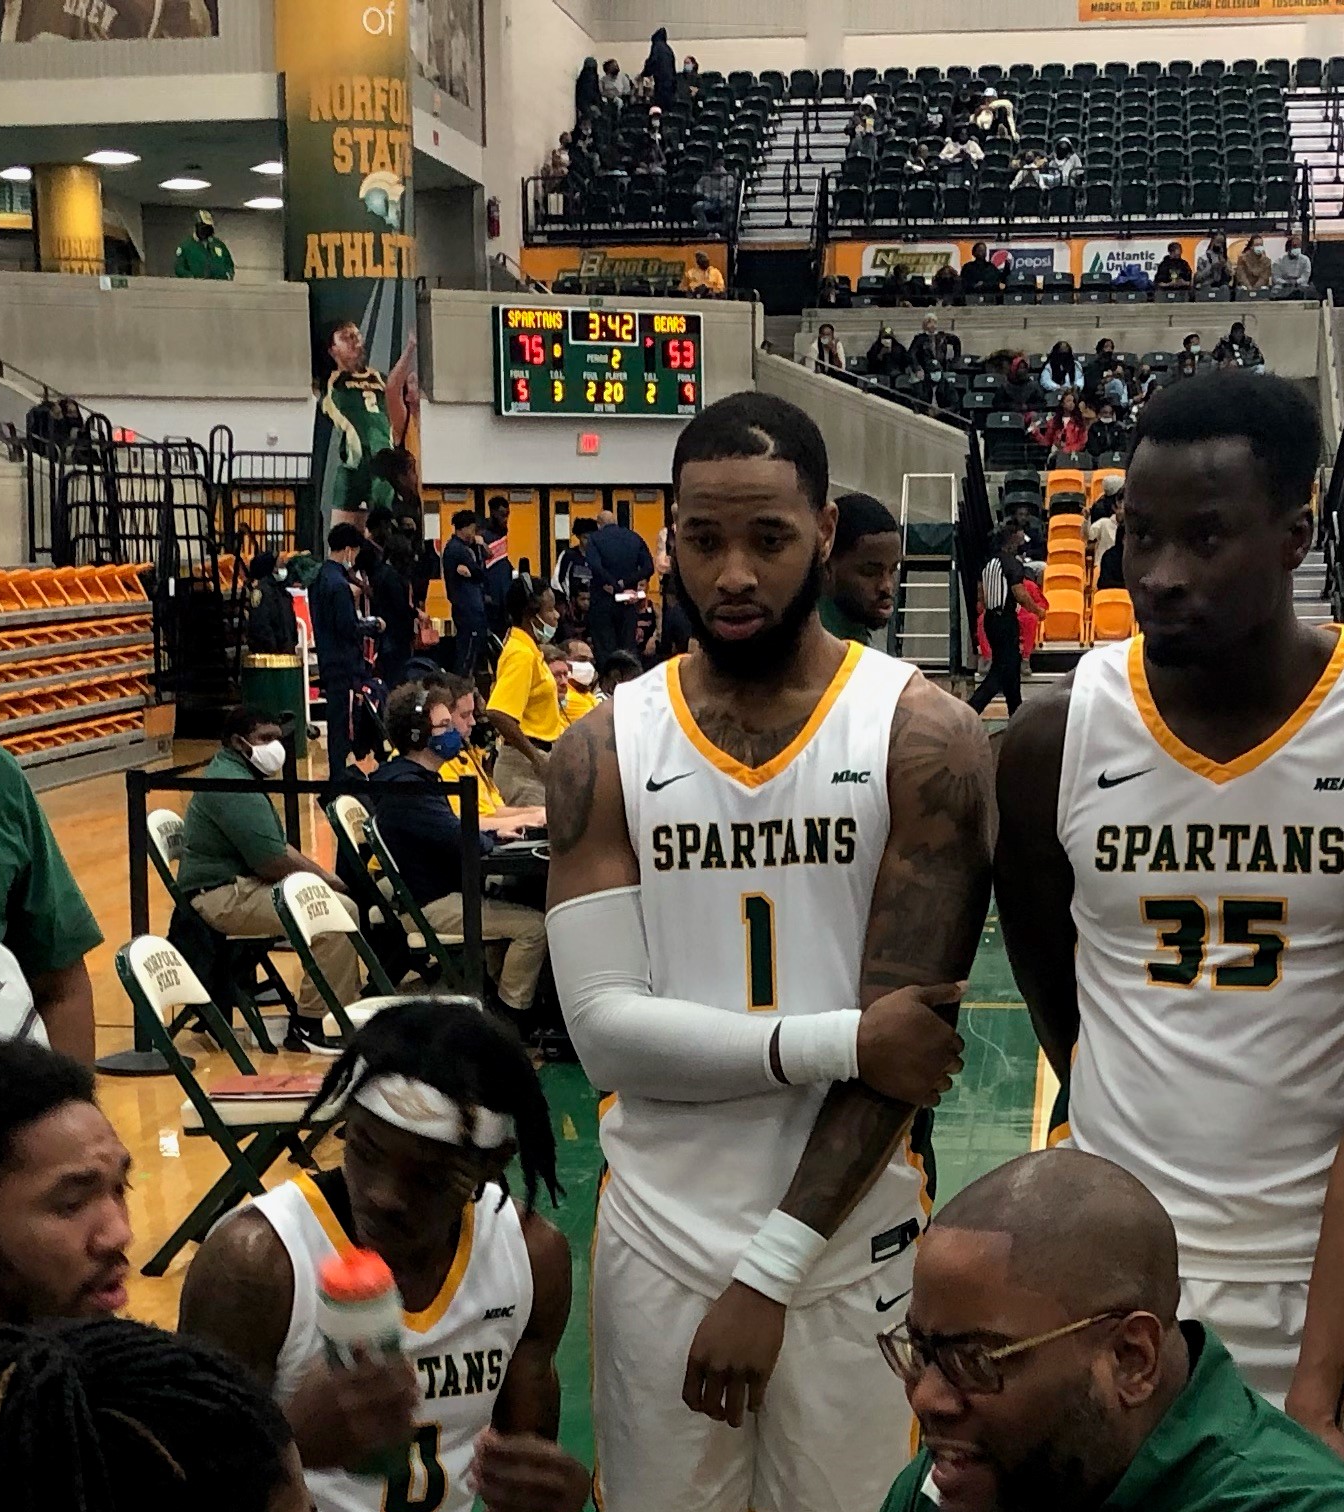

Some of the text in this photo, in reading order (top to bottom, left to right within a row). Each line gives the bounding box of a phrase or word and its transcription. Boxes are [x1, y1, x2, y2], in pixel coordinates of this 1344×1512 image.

[309, 75, 413, 125] NORFO
[304, 231, 417, 279] ATHLET
[1015, 255, 1052, 269] pepsi
[1107, 251, 1155, 261] Atlantic
[507, 310, 563, 329] SPARTANS
[588, 312, 634, 341] 3:42
[653, 315, 687, 333] BEARS
[518, 334, 545, 365] 75
[611, 348, 621, 370] 2
[668, 338, 696, 369] 53
[517, 380, 530, 403] 5
[553, 380, 564, 403] 3
[586, 381, 624, 403] 2 20
[645, 382, 657, 404] 2
[683, 382, 695, 403] 9
[652, 816, 858, 872] SPARTANS
[294, 885, 331, 909] NORFOLK
[306, 900, 330, 920] STATE
[741, 891, 778, 1012] 1
[1138, 895, 1289, 991] 35
[143, 949, 182, 979] NORFOLK
[156, 968, 181, 992] STATE
[417, 1349, 504, 1400] TANS
